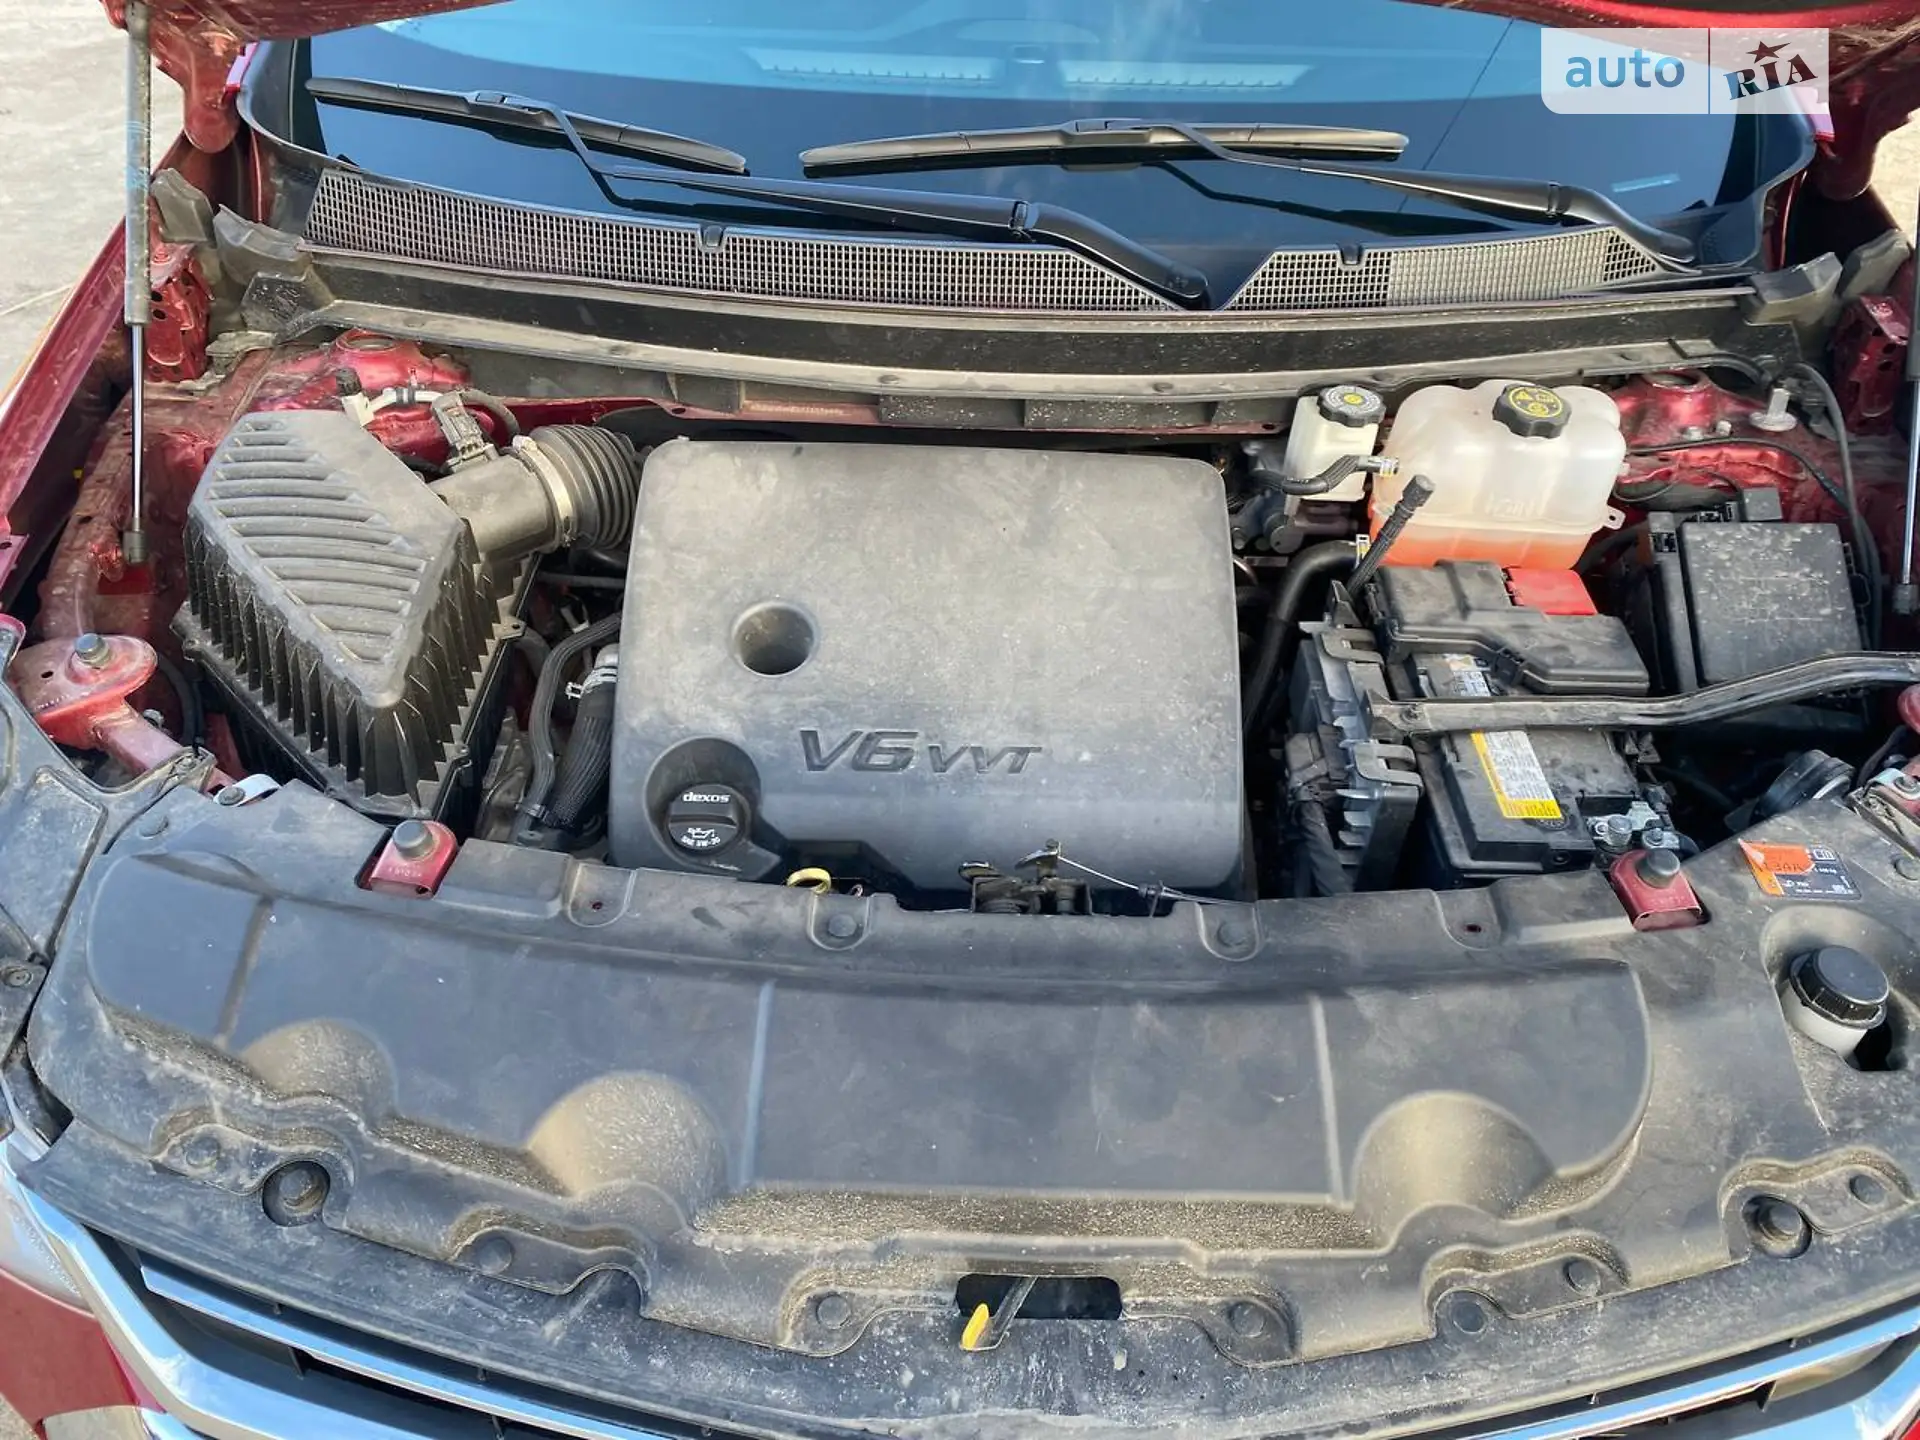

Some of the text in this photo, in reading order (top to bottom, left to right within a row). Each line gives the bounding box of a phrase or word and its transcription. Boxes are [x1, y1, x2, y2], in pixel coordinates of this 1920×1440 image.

[800, 729, 1042, 774] V6 VVT
[683, 791, 731, 802] dexos
